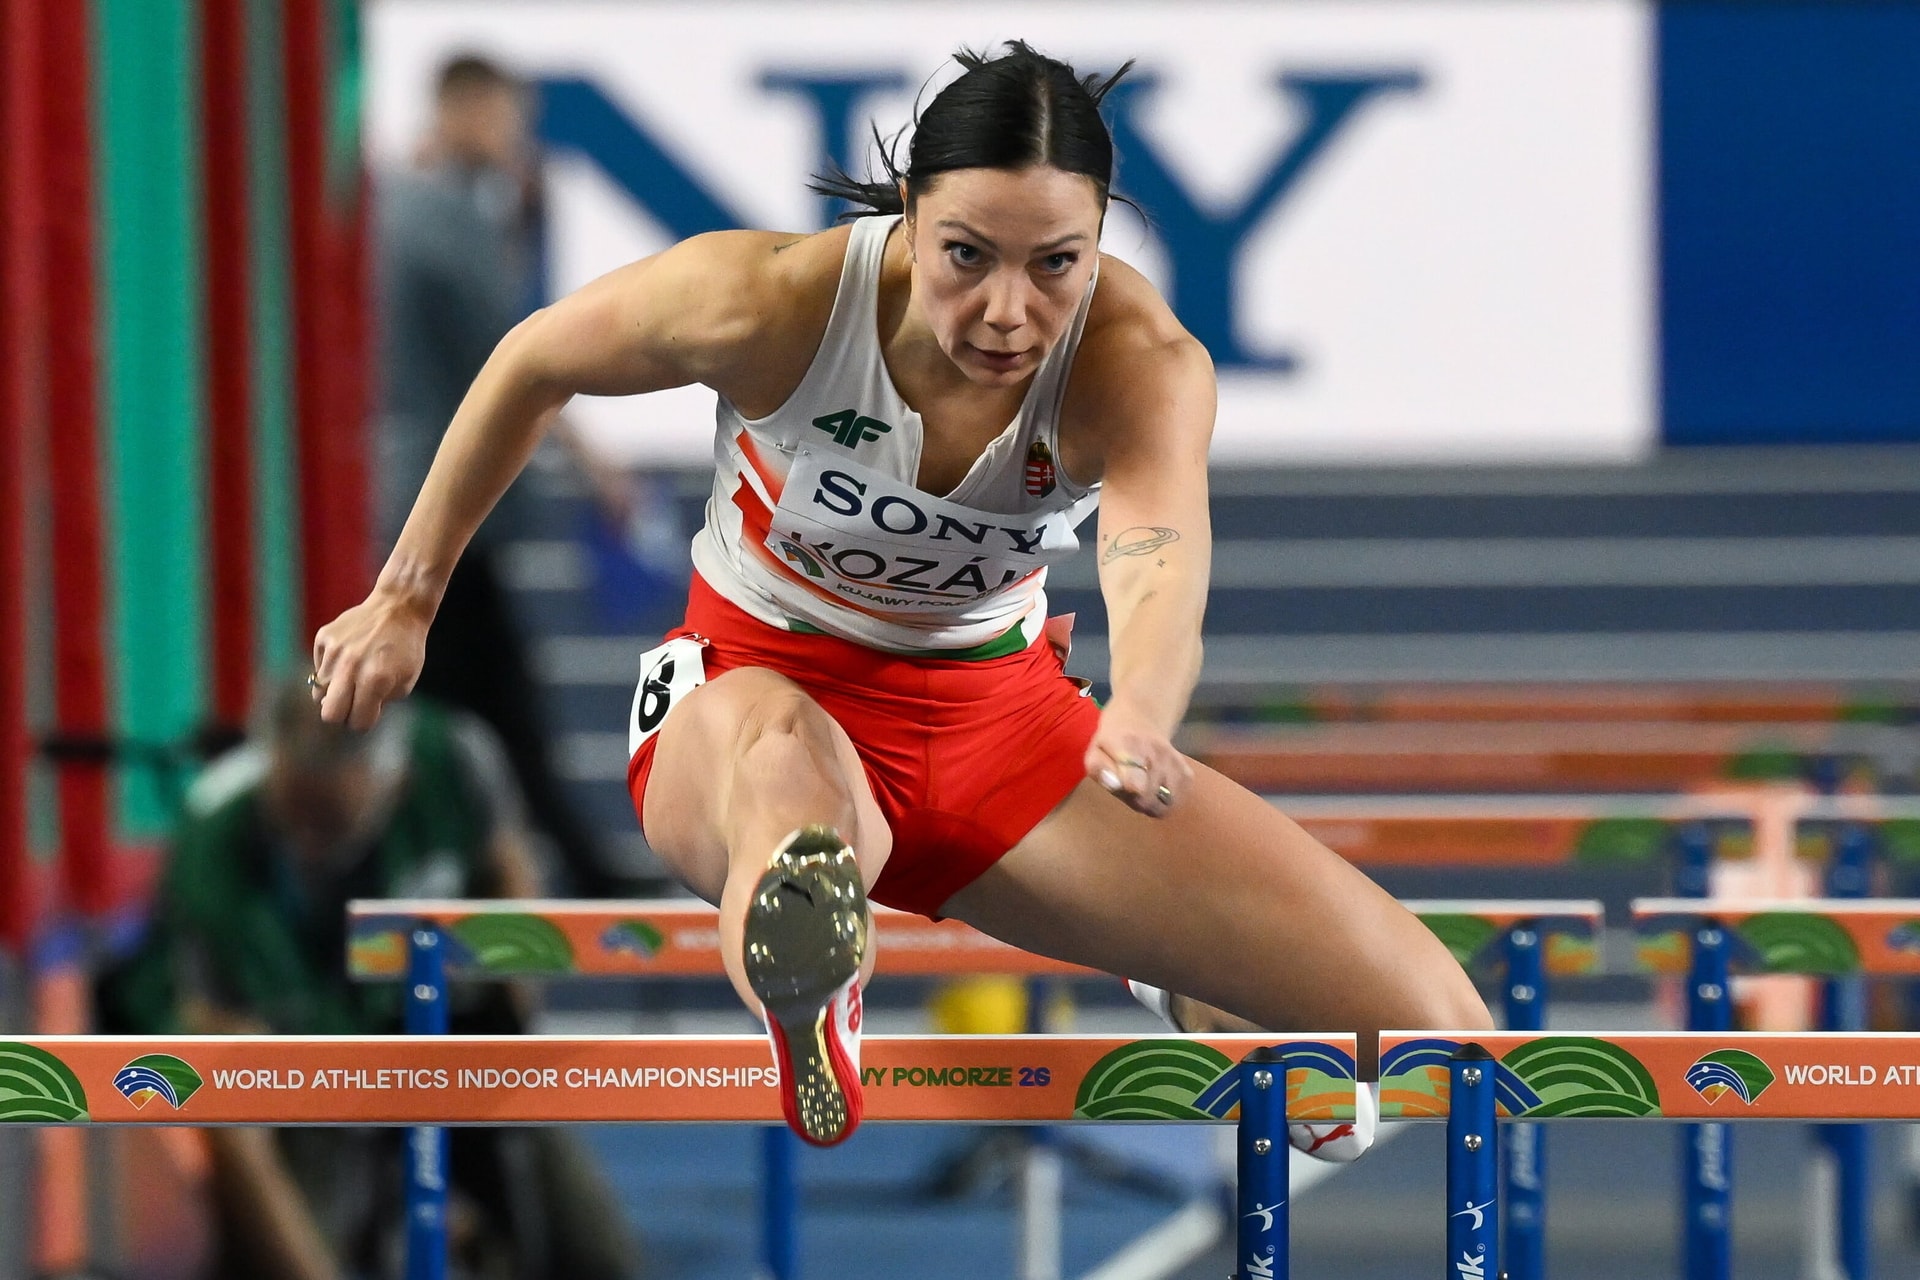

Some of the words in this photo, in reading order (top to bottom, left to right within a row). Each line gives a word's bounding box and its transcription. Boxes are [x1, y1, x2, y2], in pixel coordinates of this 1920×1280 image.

[812, 409, 892, 450] 4F
[813, 470, 1047, 555] SONY
[837, 583, 914, 606] KUJAWY
[639, 652, 675, 733] 6
[212, 1069, 304, 1089] WORLD
[311, 1069, 449, 1089] ATHLETICS
[457, 1068, 558, 1089] INDOOR
[564, 1067, 780, 1089] CHAMPIONSHIPS
[893, 1067, 1012, 1087] POMORZE
[1018, 1067, 1051, 1087] 26
[1784, 1065, 1877, 1085] WORLD
